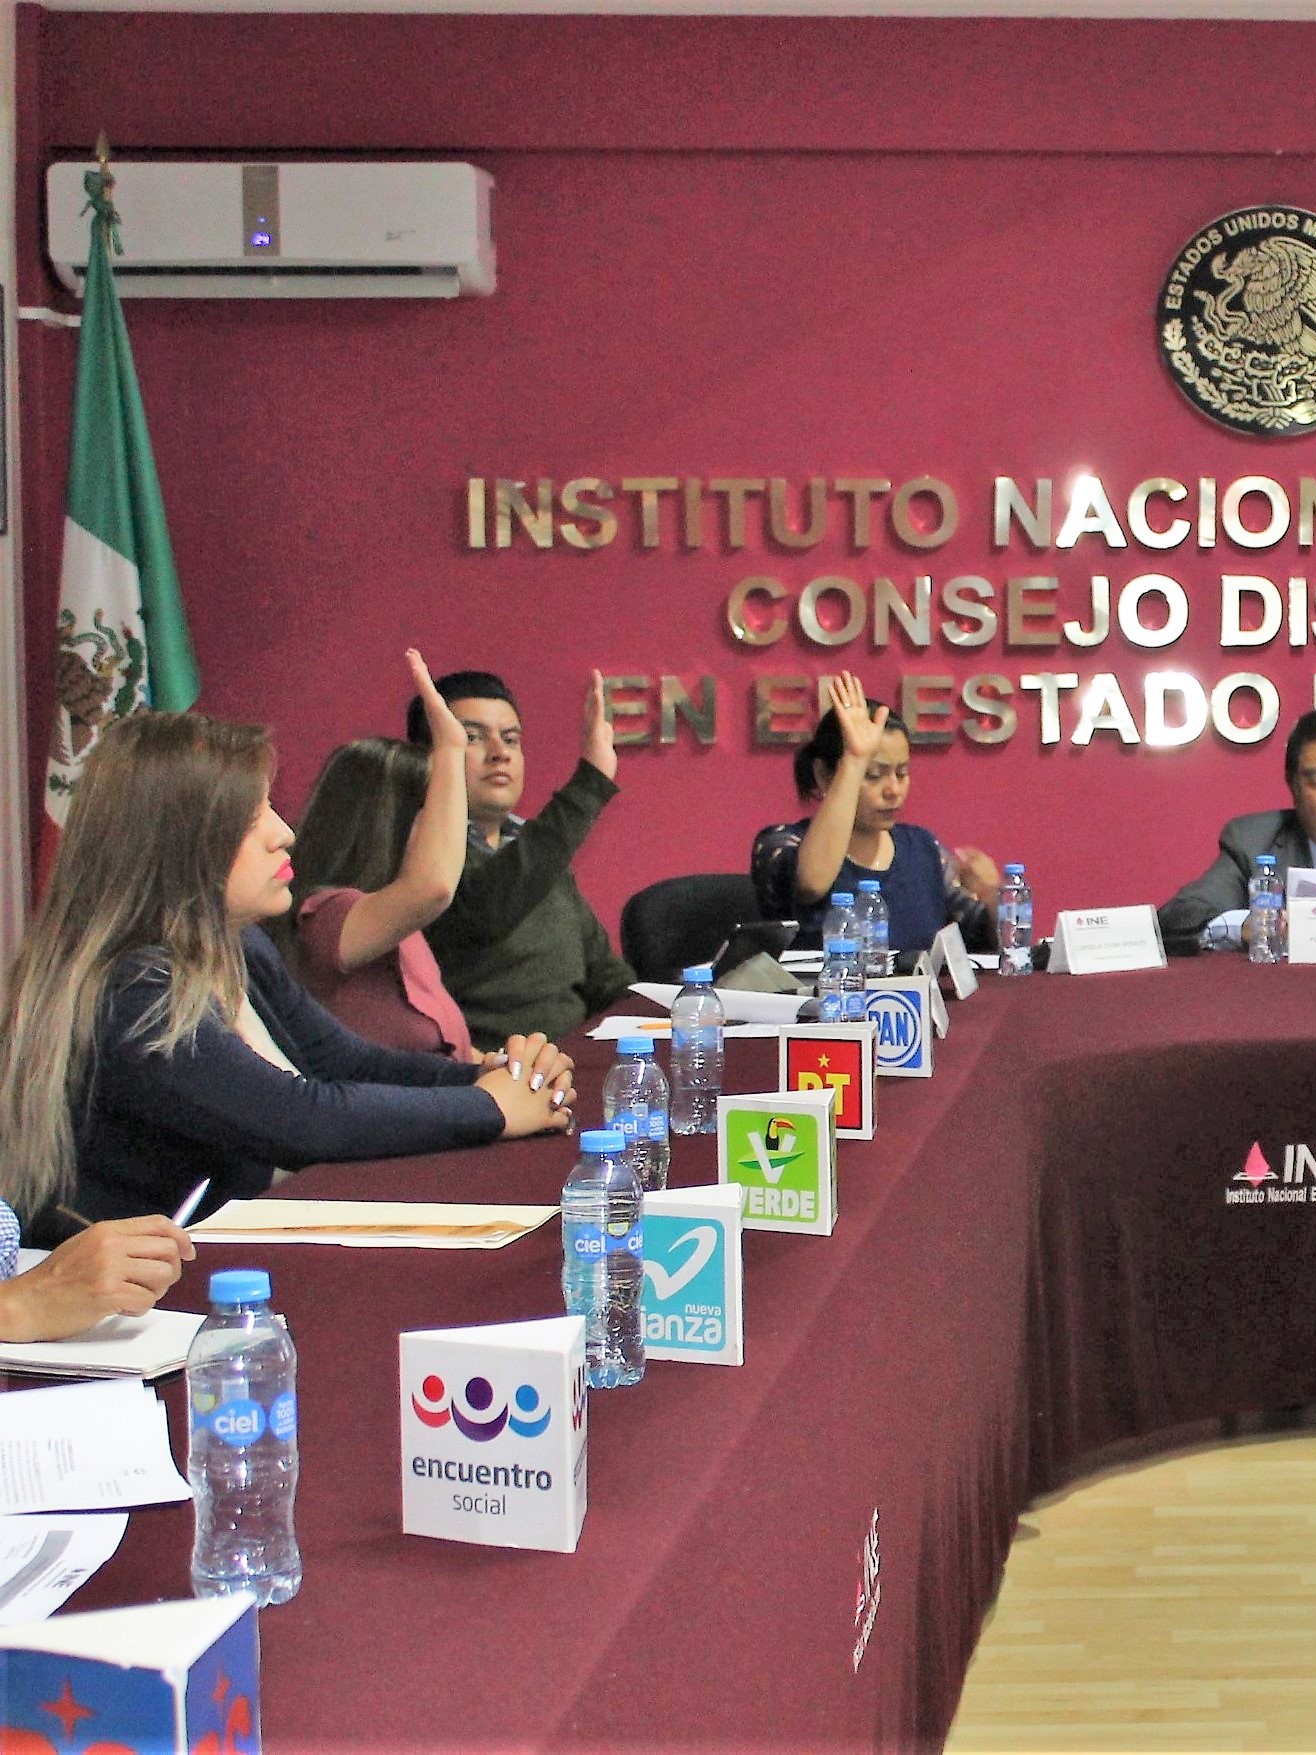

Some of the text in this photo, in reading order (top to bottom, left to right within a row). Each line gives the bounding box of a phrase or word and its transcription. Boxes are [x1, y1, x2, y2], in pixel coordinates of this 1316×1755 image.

[1166, 228, 1223, 310] ESTADOS
[1224, 212, 1300, 237] UNIDOS
[467, 476, 959, 549] INSTITUTO
[727, 574, 1190, 648] CONSEJO
[604, 674, 717, 745] EN
[902, 671, 1280, 747] ESTADO
[1086, 916, 1110, 926] INE
[1225, 1187, 1266, 1204] Instituto
[1267, 1186, 1307, 1204] Nacional
[574, 1233, 607, 1254] ciel
[627, 1229, 644, 1251] cie
[685, 1303, 722, 1316] nueva
[640, 1305, 723, 1345] ianza
[214, 1408, 260, 1435] ciel
[412, 1455, 553, 1491] encuentro
[453, 1493, 507, 1516] social
